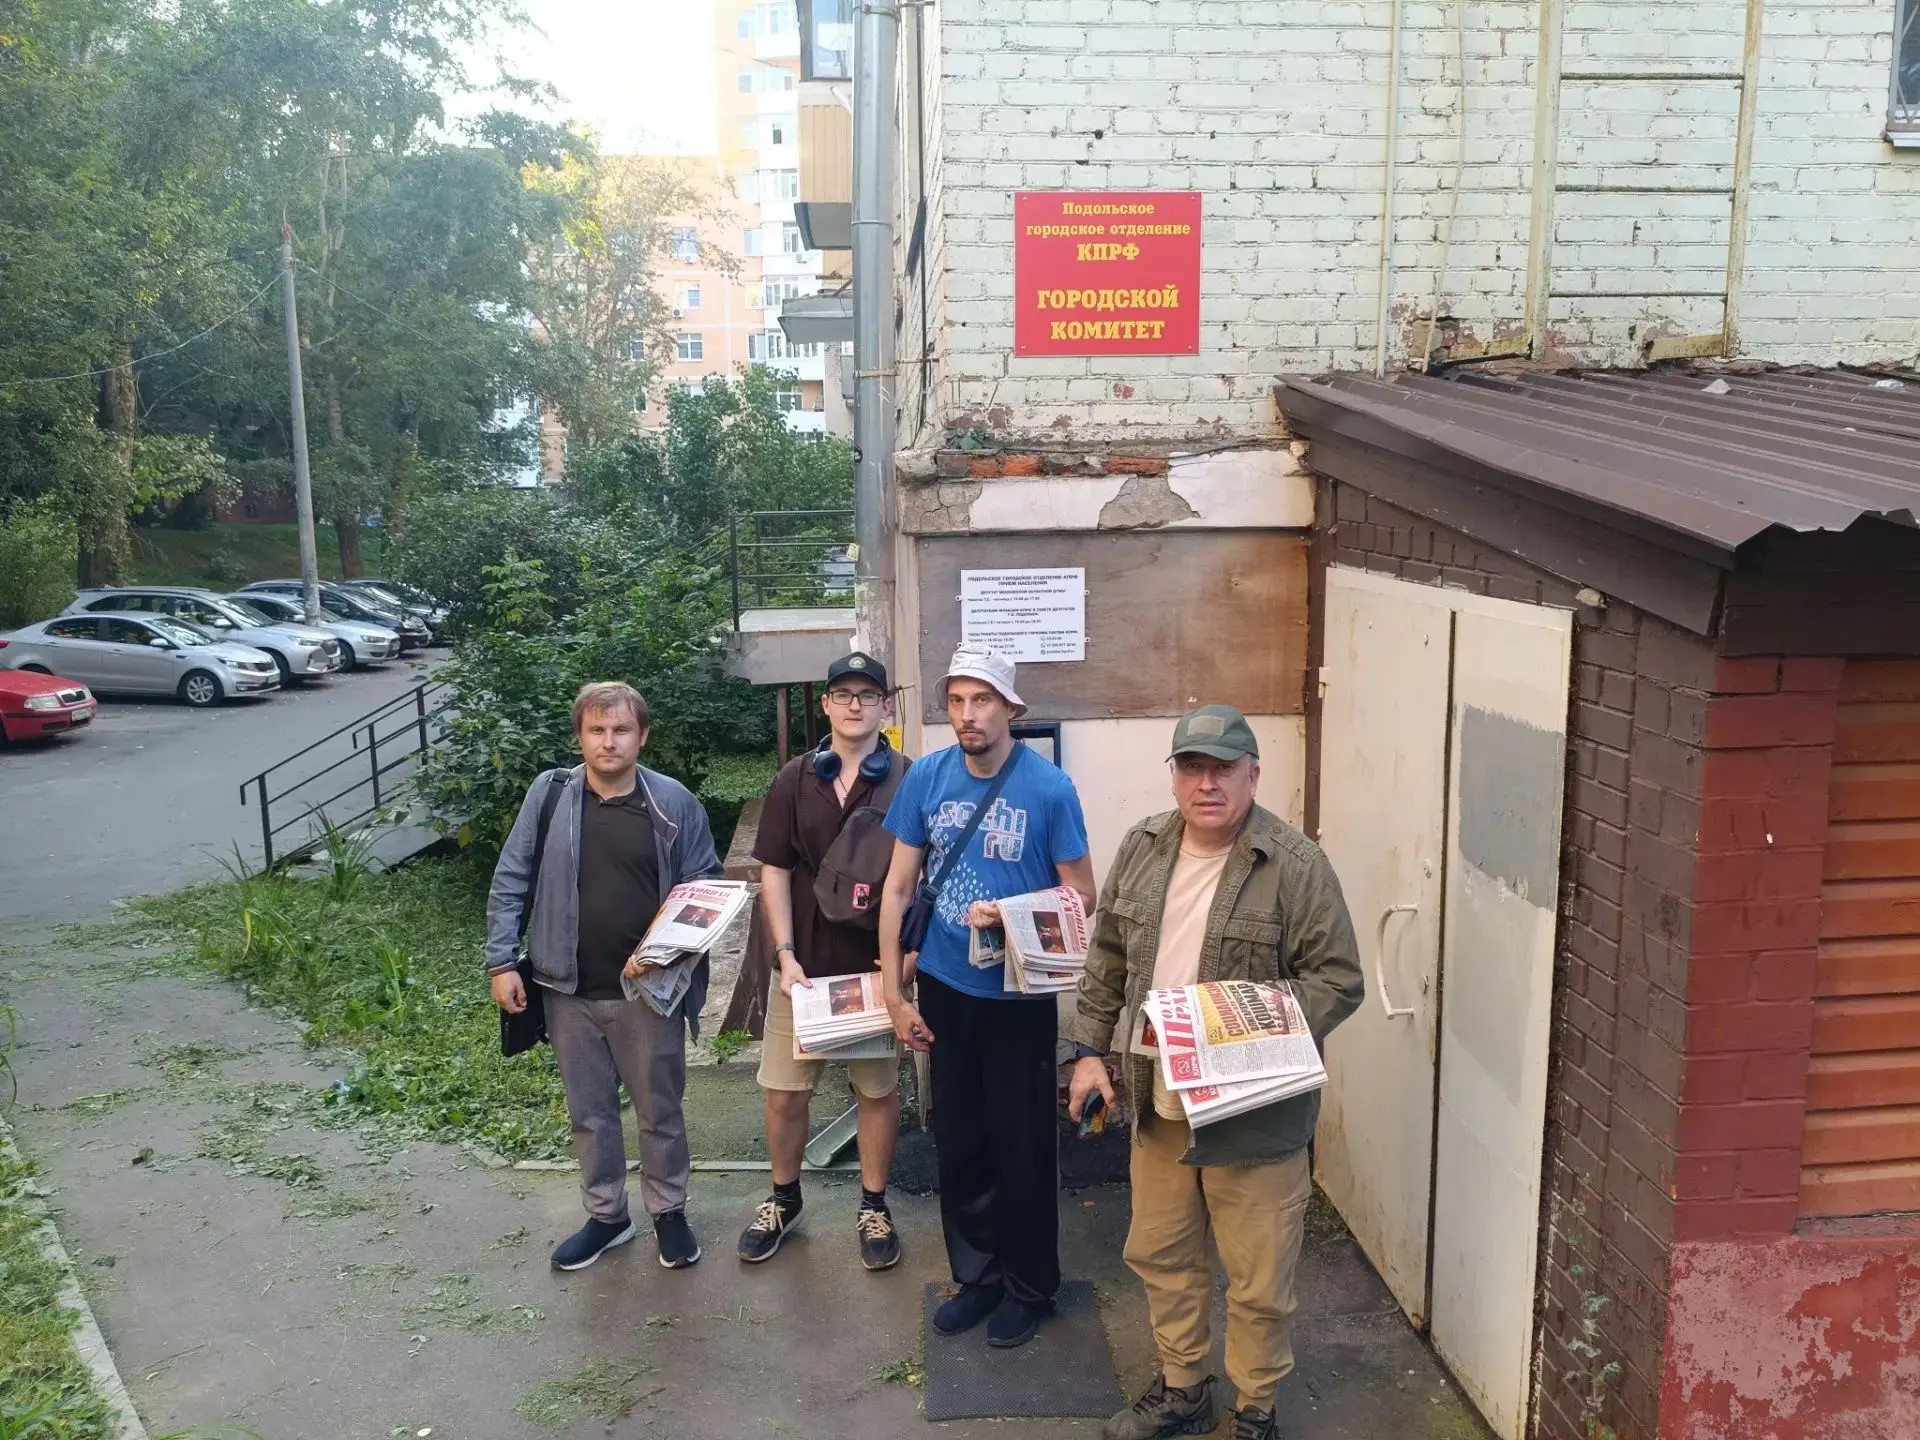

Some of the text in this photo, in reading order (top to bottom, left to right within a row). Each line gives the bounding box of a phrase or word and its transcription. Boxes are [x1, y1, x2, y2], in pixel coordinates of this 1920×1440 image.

[1062, 202, 1155, 217] Подольское
[1026, 223, 1191, 238] городское отделение
[1076, 243, 1140, 261] КПРФ
[1037, 284, 1179, 312] ГОРОДСКОЙ
[1050, 320, 1165, 340] КОМИТЕТ
[1237, 983, 1277, 1030] КОШМАР
